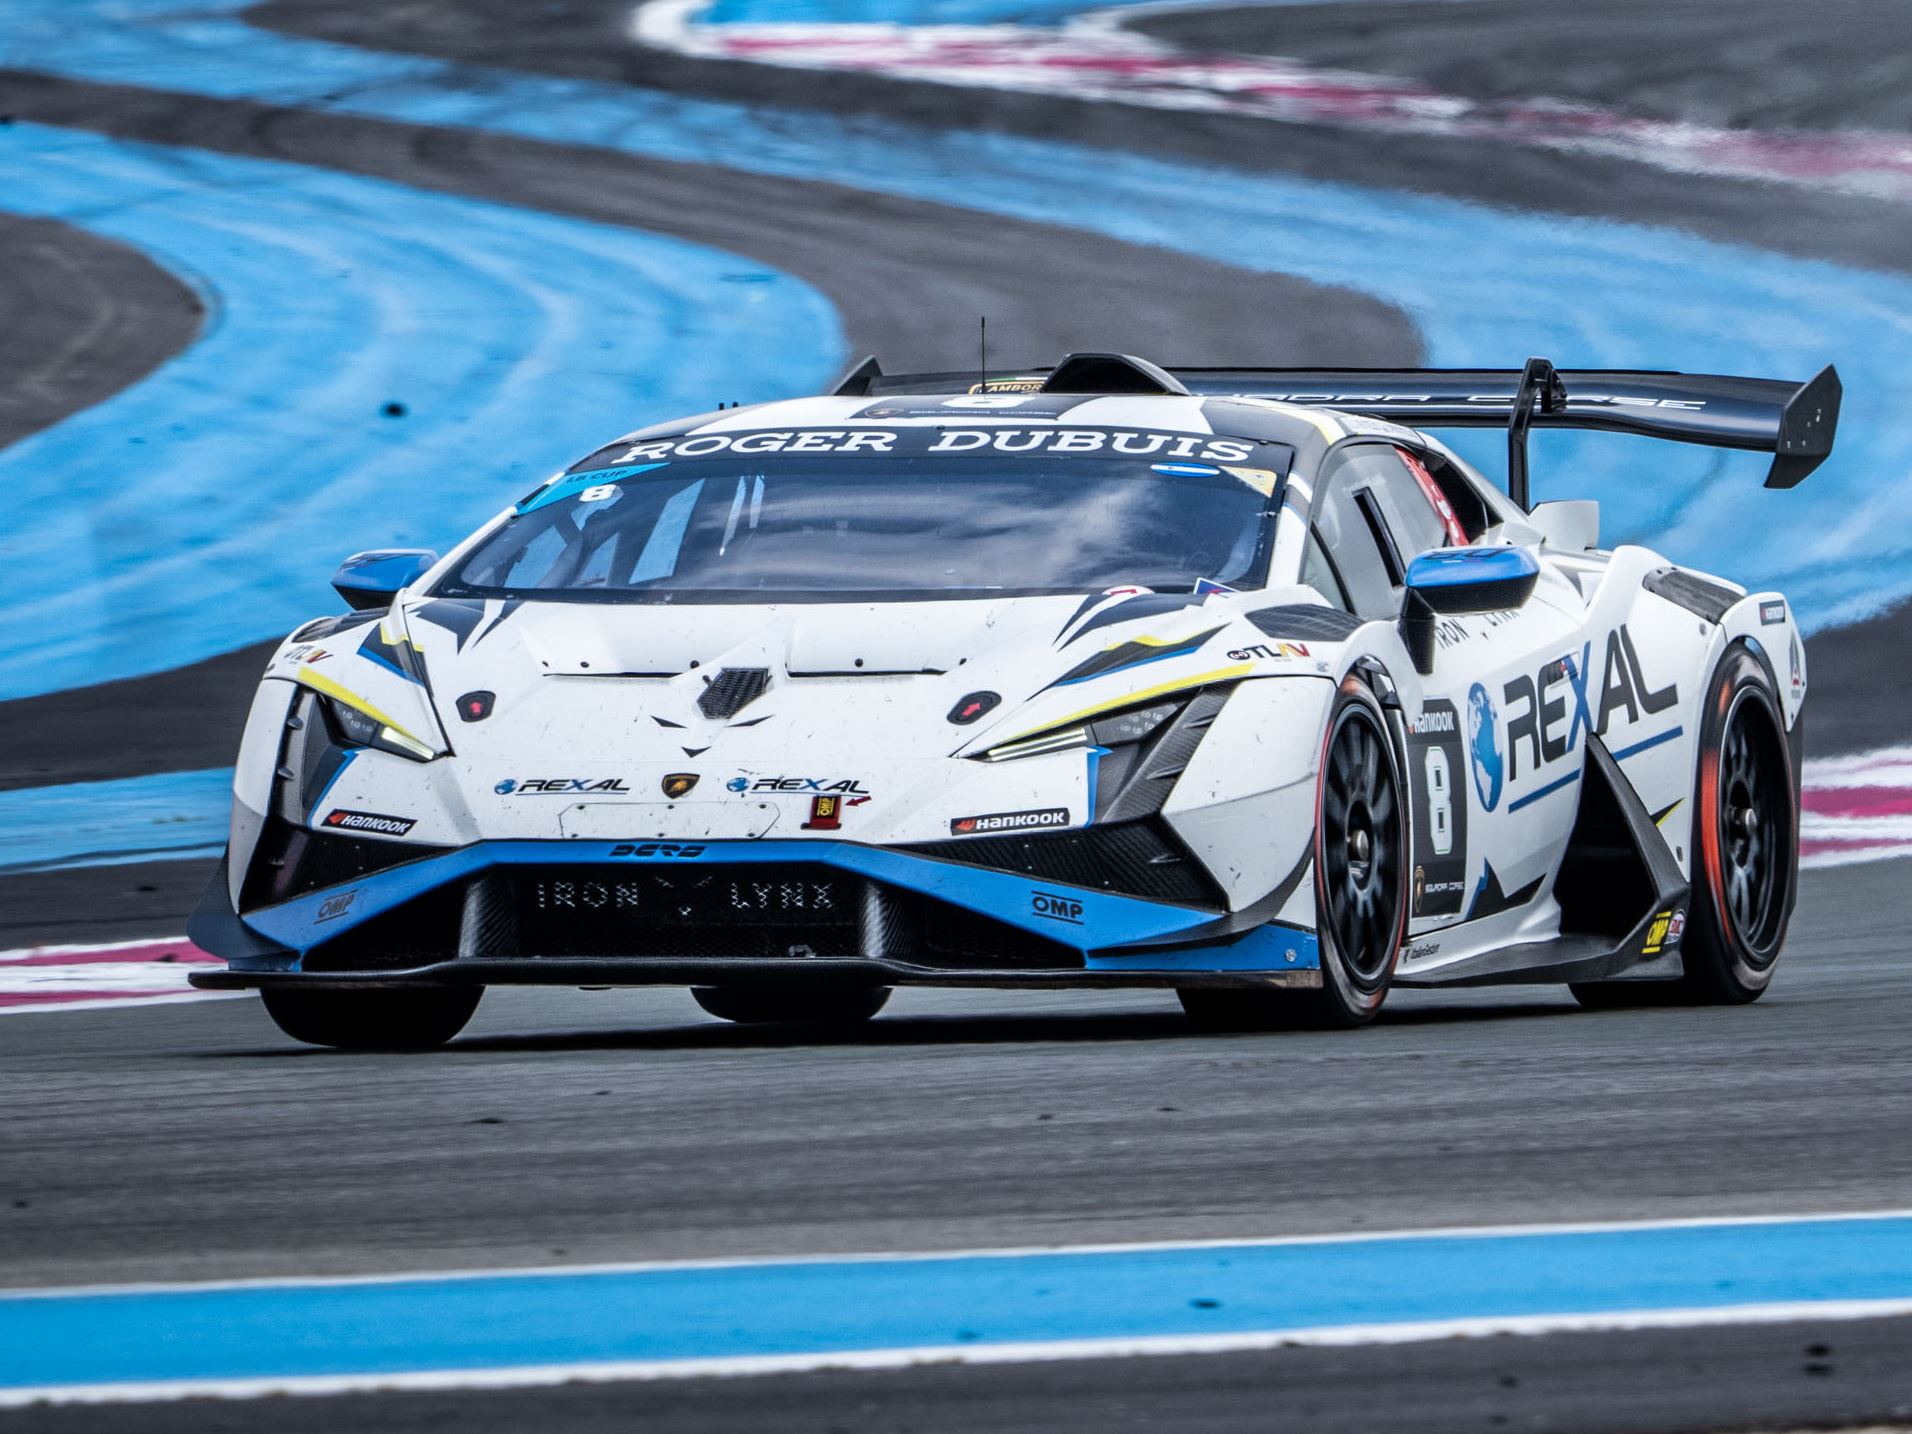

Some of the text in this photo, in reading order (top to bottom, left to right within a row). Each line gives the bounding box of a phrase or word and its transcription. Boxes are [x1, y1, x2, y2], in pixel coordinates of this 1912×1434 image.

[1467, 395, 1706, 410] CRSE
[611, 431, 1254, 464] ROGER DUBUIS
[591, 470, 628, 480] CUP
[579, 484, 617, 502] 8
[1503, 623, 1679, 783] REXAL
[518, 778, 630, 792] REXAL
[752, 777, 869, 794] REXAL
[1424, 745, 1453, 855] 8
[318, 894, 355, 918] OMP
[537, 881, 833, 909] IRON LYNX
[1032, 896, 1083, 919] OMP
